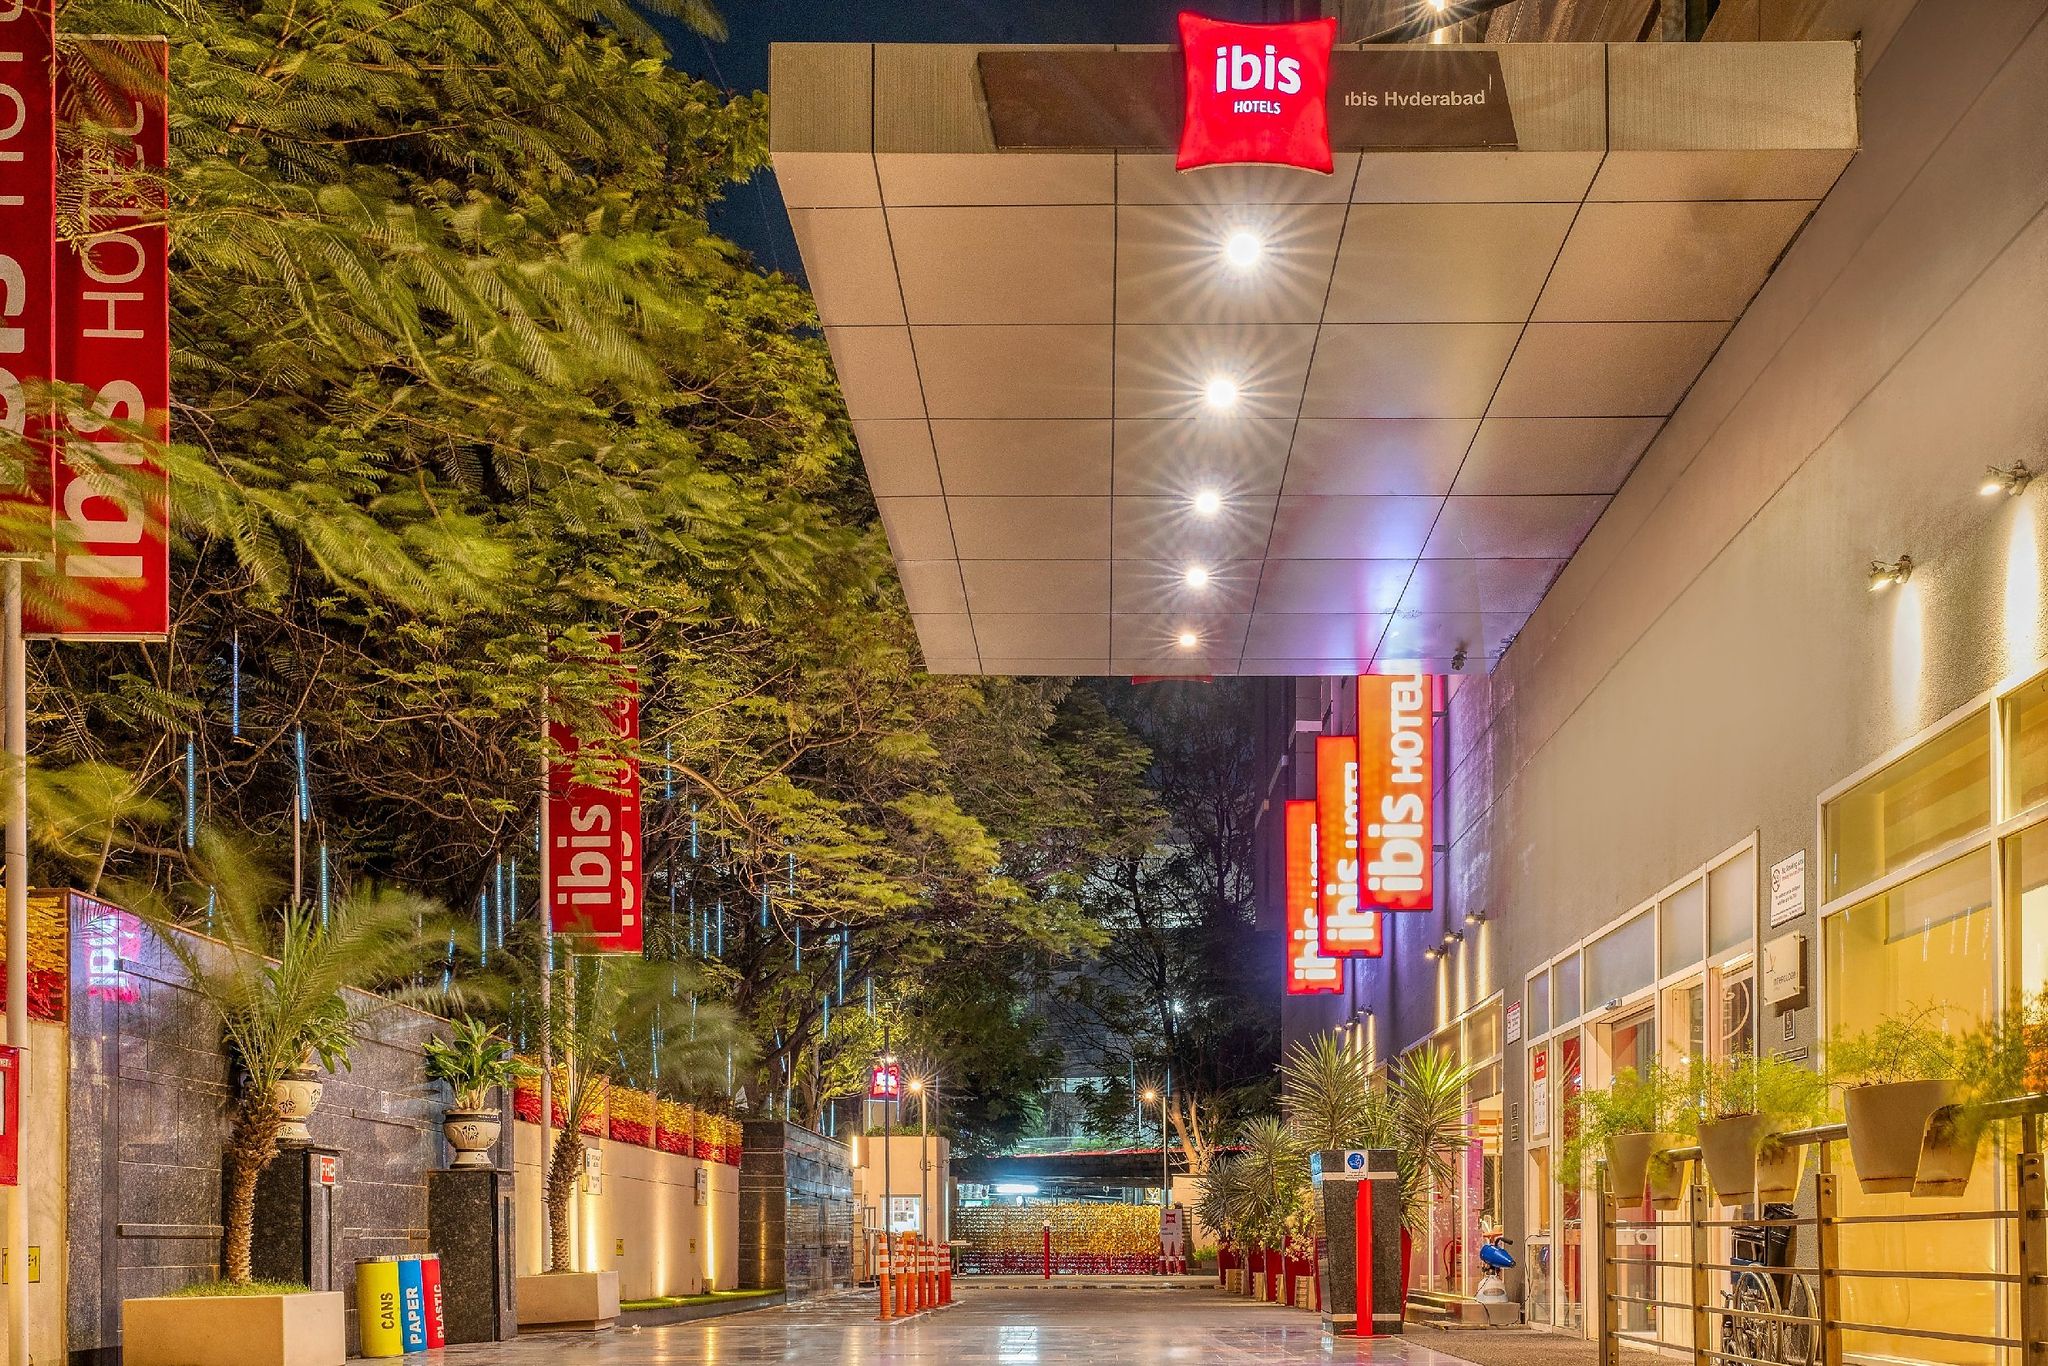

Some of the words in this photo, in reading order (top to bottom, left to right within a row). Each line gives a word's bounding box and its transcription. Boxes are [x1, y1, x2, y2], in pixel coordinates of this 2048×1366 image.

[1216, 45, 1301, 94] ibis
[1233, 100, 1281, 115] HOTELS
[557, 804, 612, 905] ibis
[1368, 793, 1424, 891] ibis
[380, 1292, 395, 1330] CANS
[406, 1286, 423, 1345] PAPER
[434, 1284, 445, 1339] PLASTIC
